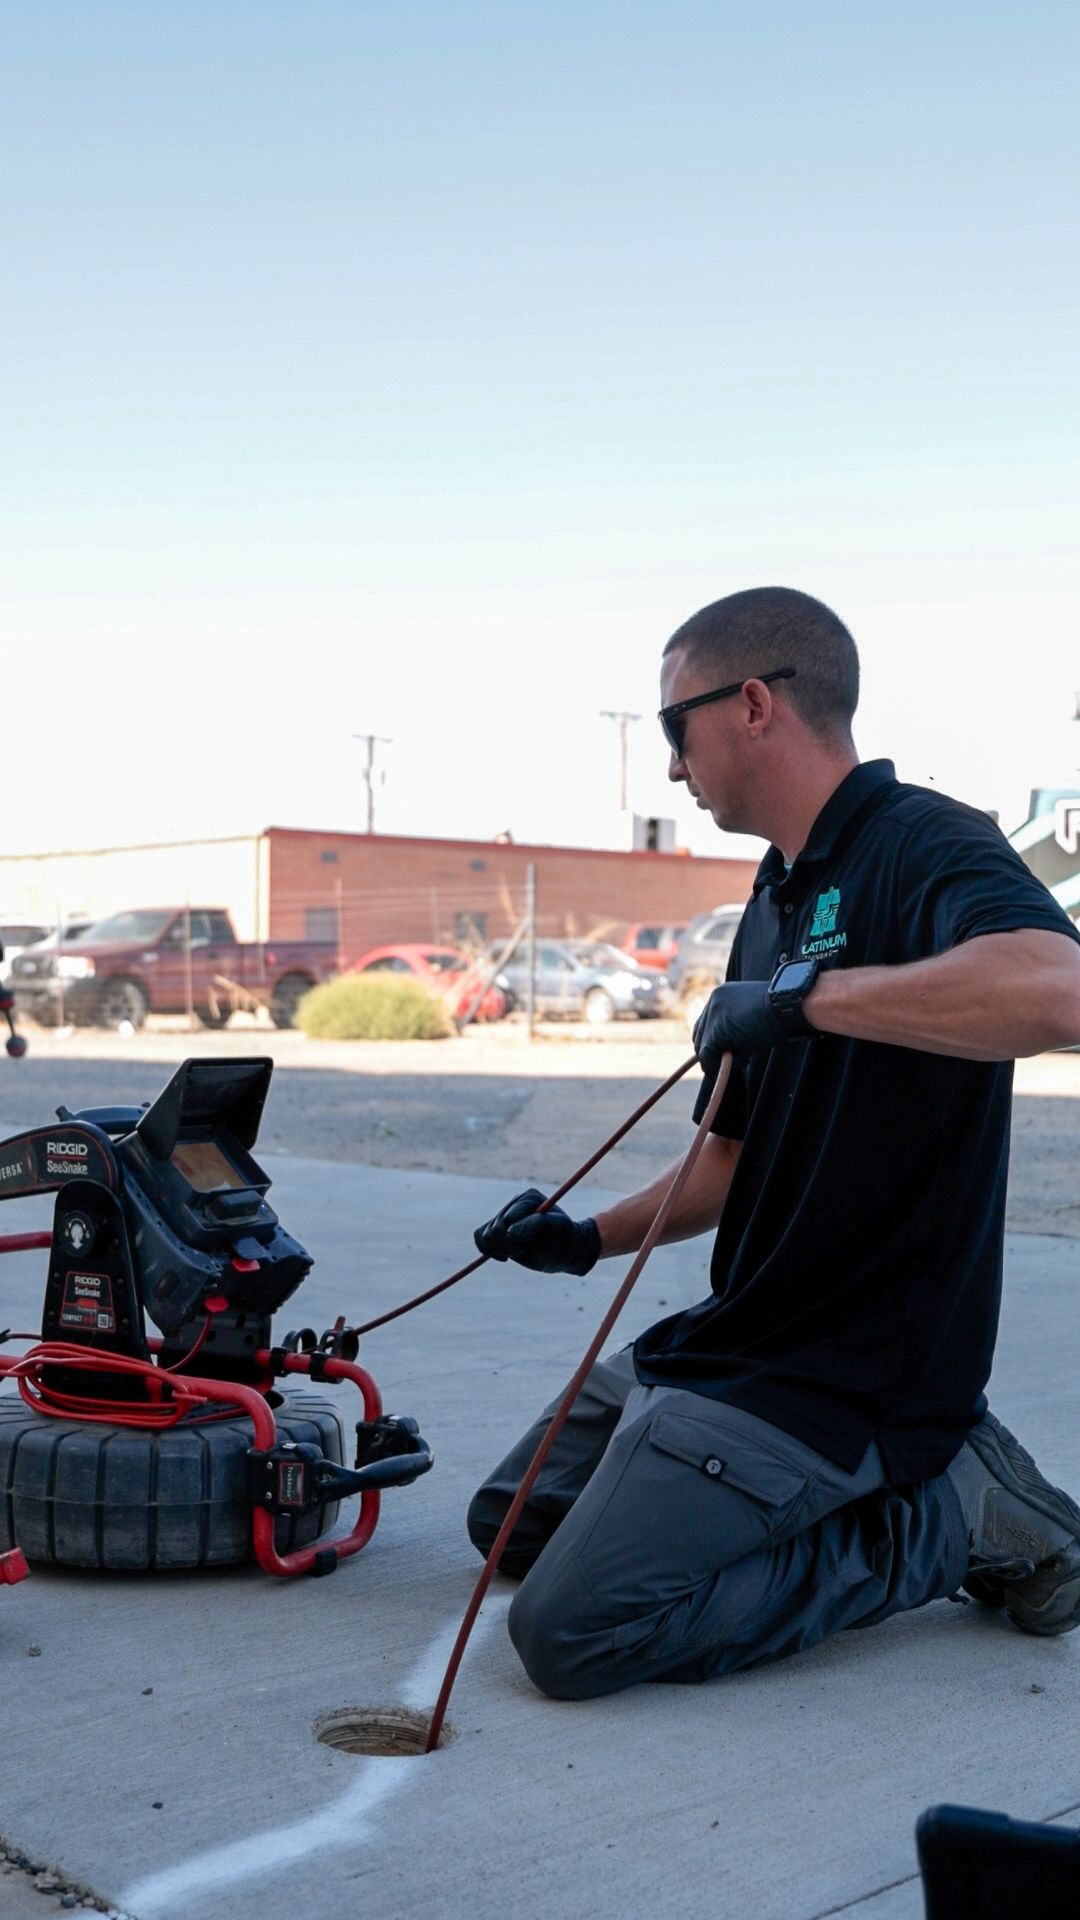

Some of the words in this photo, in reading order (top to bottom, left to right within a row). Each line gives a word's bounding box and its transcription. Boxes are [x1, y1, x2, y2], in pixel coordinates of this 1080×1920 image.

[801, 932, 847, 955] LATINUM
[46, 1142, 88, 1156] RIDGID
[47, 1160, 88, 1175] SeeSnake
[75, 1276, 101, 1286] RIDGID
[75, 1286, 101, 1298] SeeSnake
